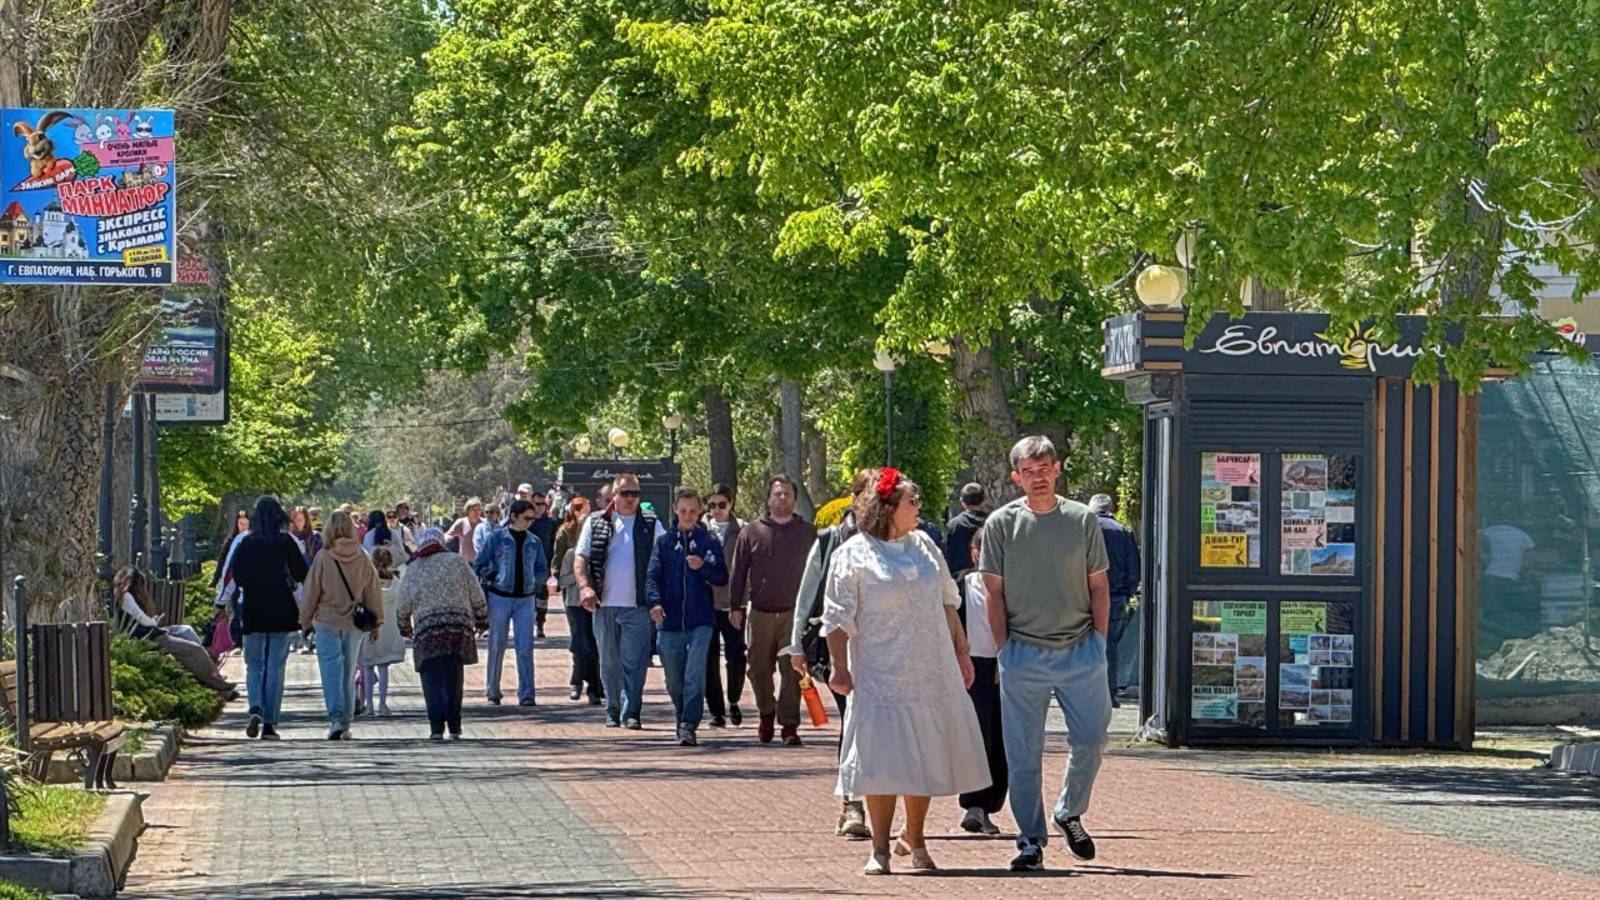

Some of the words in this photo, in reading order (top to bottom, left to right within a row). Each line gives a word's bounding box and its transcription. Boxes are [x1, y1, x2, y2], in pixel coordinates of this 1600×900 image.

[107, 143, 131, 151] ОЧЕНЬ
[132, 140, 159, 148] МИЛЫЕ
[117, 150, 148, 158] КРОЛИКИ
[20, 177, 54, 190] ЗАЙКИН
[57, 175, 117, 199] ПАРК
[61, 183, 169, 217] МИНИАТЮР
[97, 207, 166, 232] ЭКСПРЕСС
[98, 221, 167, 243] ЗНАКОМСТВО
[8, 265, 16, 276] Г.
[18, 265, 74, 277] ЕВПАТОРИЯ,
[76, 266, 97, 277] НАБ.
[99, 266, 148, 278] ГОРЬКОГО,
[151, 267, 162, 277] 16
